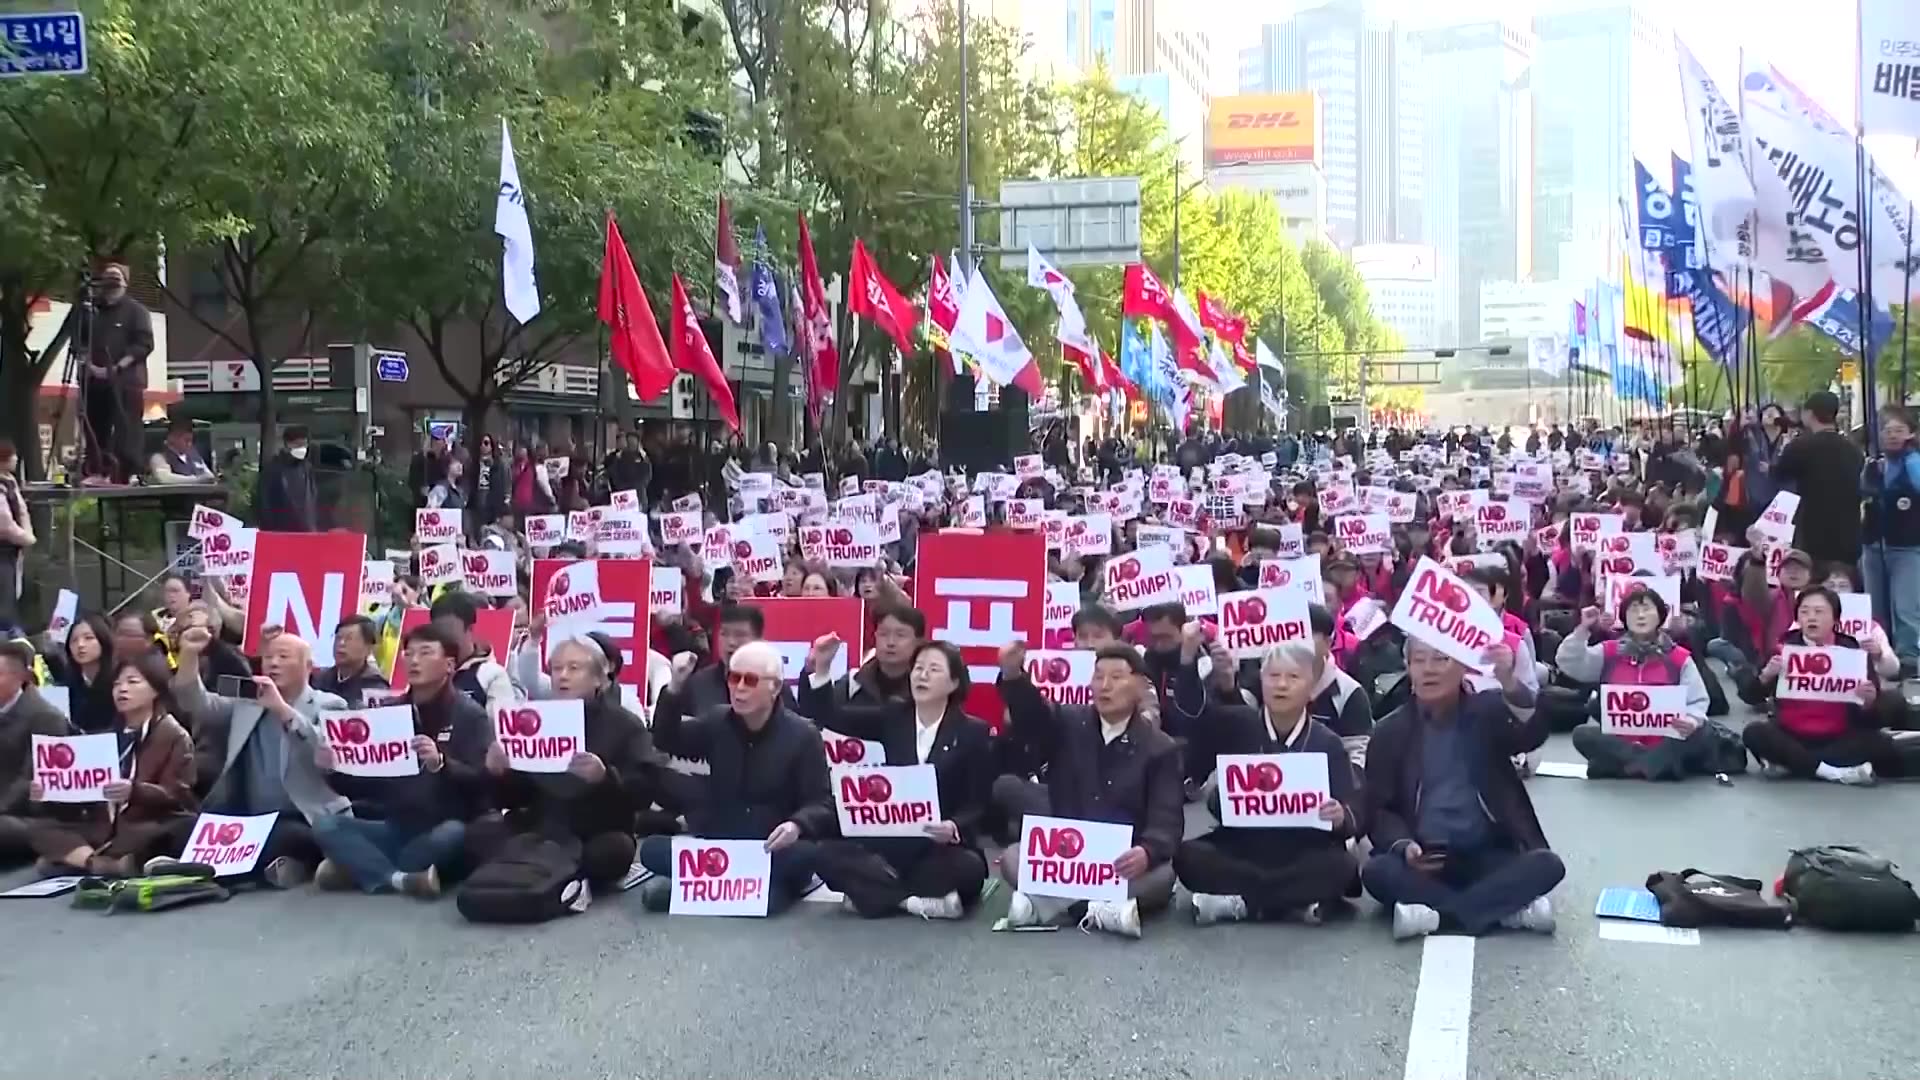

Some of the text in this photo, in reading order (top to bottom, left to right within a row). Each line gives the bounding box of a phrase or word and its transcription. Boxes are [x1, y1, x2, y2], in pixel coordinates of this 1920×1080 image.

[1228, 111, 1300, 129] DHL
[1008, 502, 1026, 514] NO
[1170, 501, 1194, 514] NO
[1478, 505, 1506, 520] NO
[196, 511, 223, 527] NO
[419, 512, 440, 526] NO
[528, 518, 547, 531] NO
[663, 516, 683, 529] NO
[1339, 519, 1367, 535] NO
[1479, 520, 1527, 534] TRUMP!
[1574, 517, 1600, 531] NO
[706, 529, 731, 545] NO
[802, 530, 822, 544] NO
[826, 529, 853, 545] NO
[1065, 520, 1088, 540] NO
[205, 533, 231, 553] NO
[826, 545, 876, 560] TRUMP!
[1601, 536, 1630, 552] NO
[421, 550, 440, 566] NO
[462, 555, 489, 573] NO
[1703, 546, 1729, 563] NO
[1109, 558, 1141, 587] NO
[1601, 557, 1635, 575] NO
[1702, 561, 1735, 577] TRUM
[465, 574, 513, 589] TRUMP!
[1110, 573, 1172, 601] TRUMP!
[1415, 569, 1471, 613] NO
[548, 592, 597, 618] RUMP!
[1223, 596, 1268, 627] NO
[1409, 594, 1491, 651] TRUMP
[1223, 621, 1306, 651] TRUMP!
[1029, 657, 1070, 684] NO
[1786, 653, 1831, 675] NO
[1607, 691, 1650, 711] NO
[325, 718, 370, 744] NO
[498, 708, 542, 737] NO
[36, 742, 76, 770] NO
[332, 740, 409, 765] TRUMP!
[501, 735, 578, 760] TRUMP!
[823, 737, 866, 764] NO
[38, 766, 112, 791] TRUMP!
[1225, 762, 1283, 793] NO
[840, 773, 892, 804] NO
[844, 800, 934, 826] TRUMP!
[194, 822, 244, 846] NO
[1027, 826, 1085, 859] NO
[192, 841, 260, 864] TRUMP!
[679, 847, 729, 879] NO
[679, 877, 762, 903] TRUMP!
